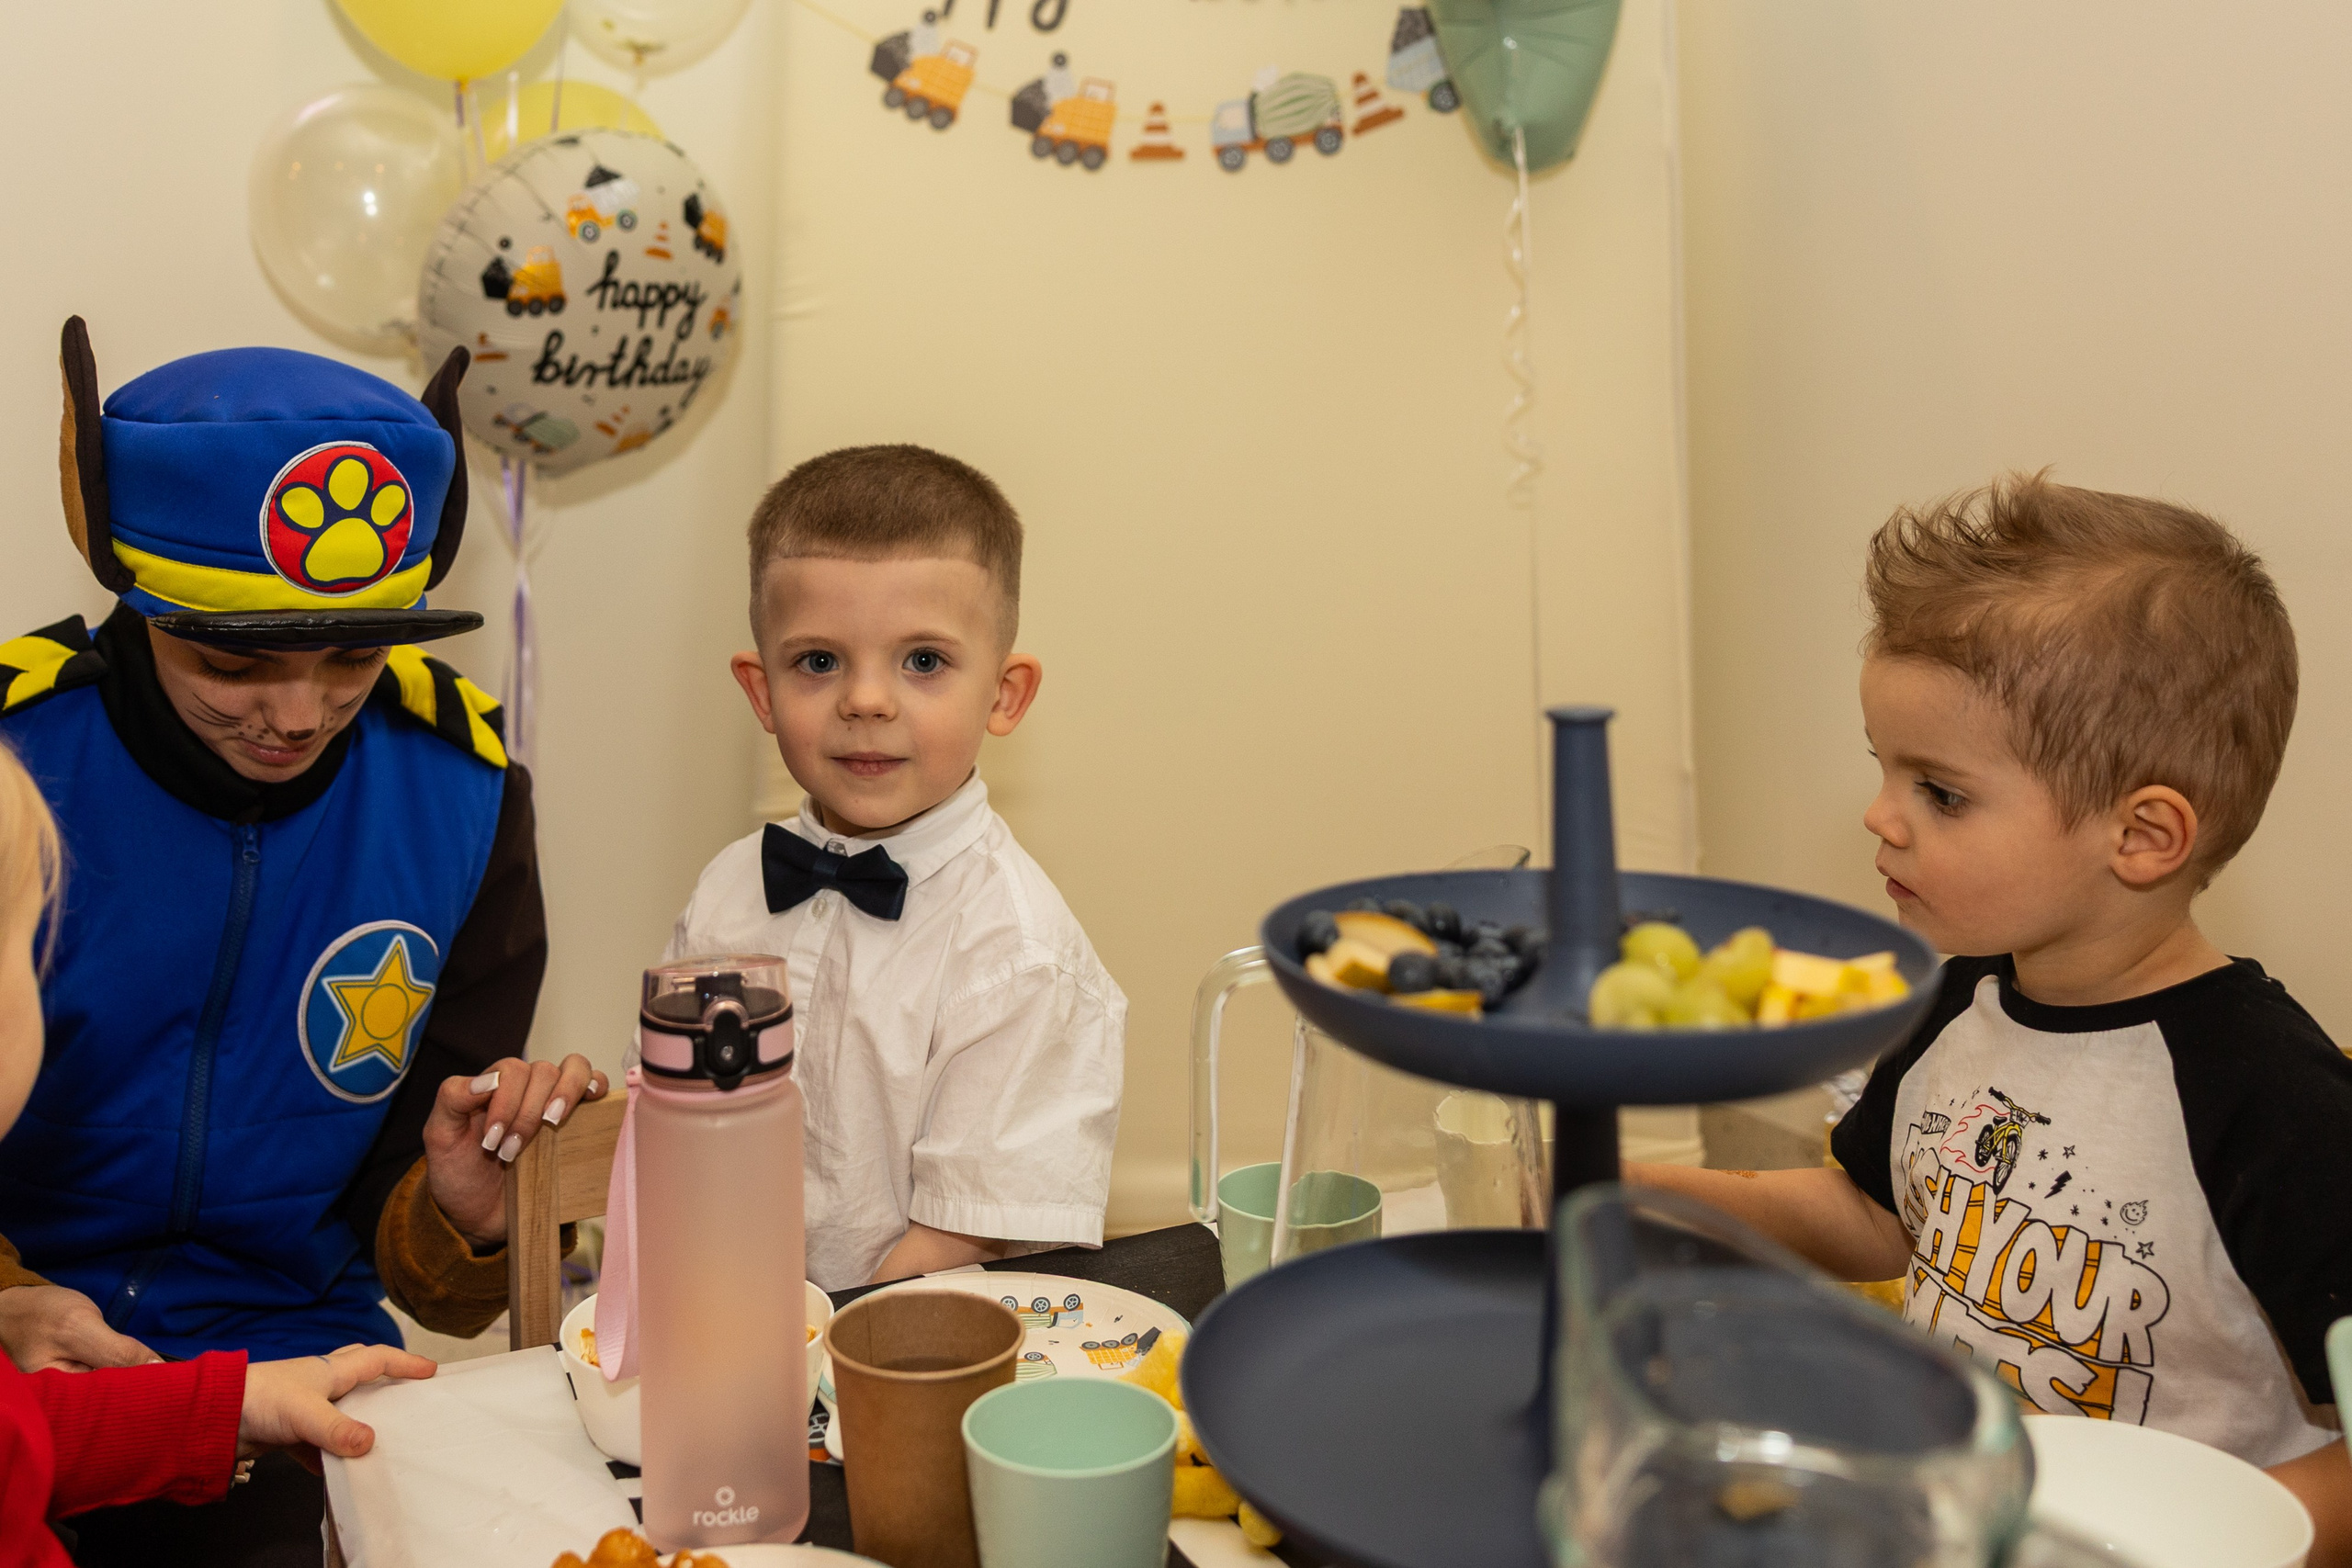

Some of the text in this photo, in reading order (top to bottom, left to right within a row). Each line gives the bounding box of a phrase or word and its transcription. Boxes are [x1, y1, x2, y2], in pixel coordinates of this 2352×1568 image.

[586, 249, 707, 340] happy
[532, 329, 712, 409] birthday
[1962, 1180, 2169, 1367] YOUR
[693, 1506, 760, 1527] rockle
